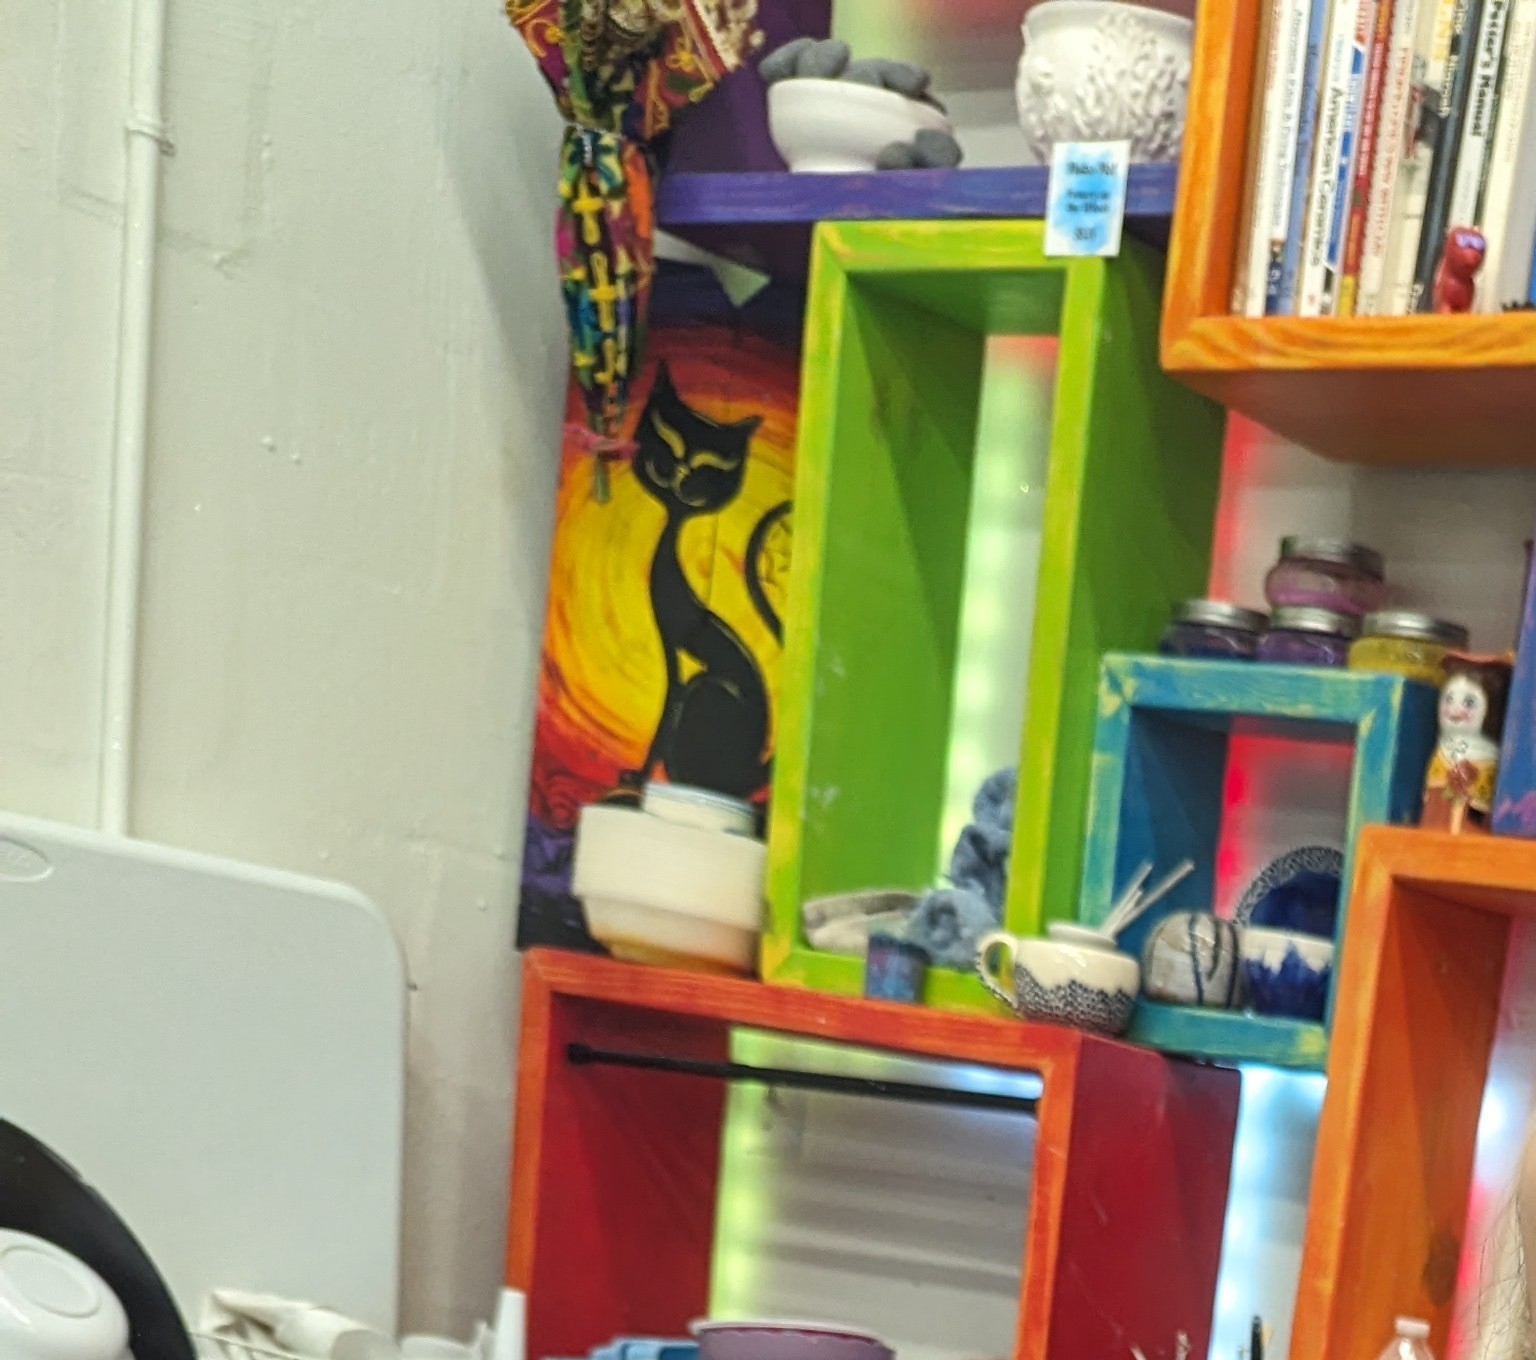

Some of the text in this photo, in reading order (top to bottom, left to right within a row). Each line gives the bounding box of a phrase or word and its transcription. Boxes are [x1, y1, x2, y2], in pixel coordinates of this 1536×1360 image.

[1321, 86, 1344, 176] American
[1470, 73, 1492, 137] Manual
[1309, 179, 1332, 268] Ceramics
